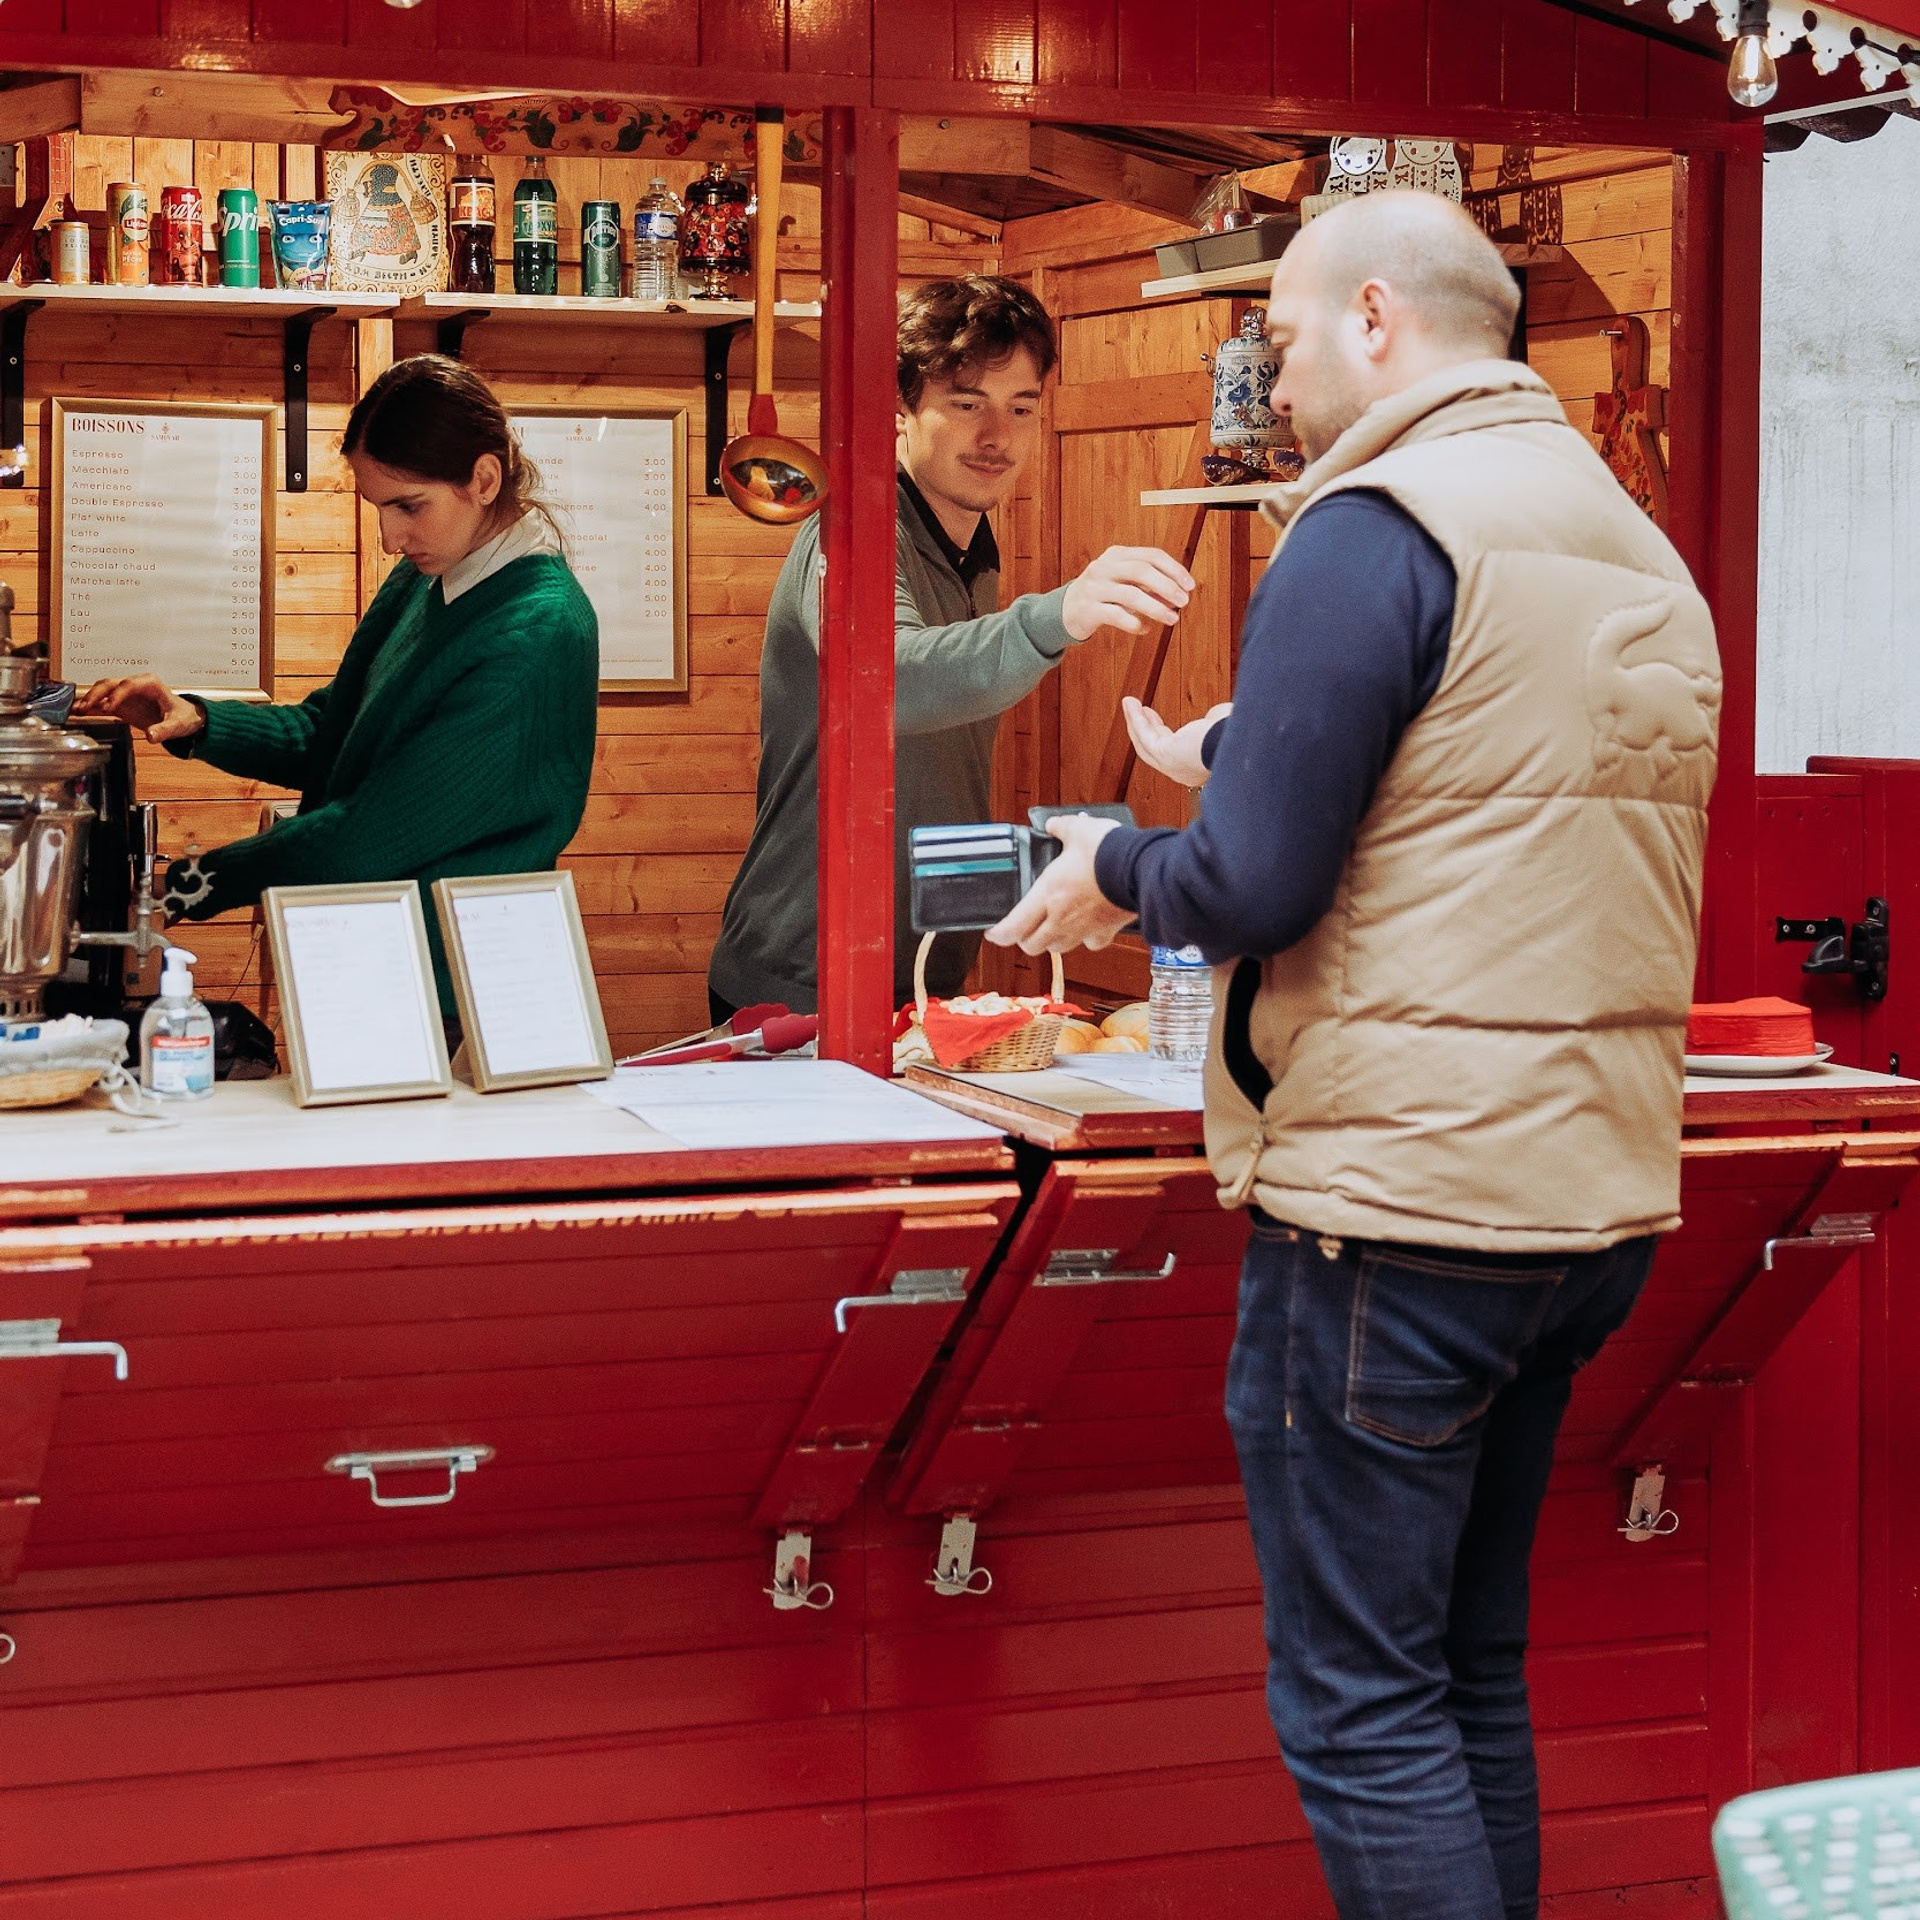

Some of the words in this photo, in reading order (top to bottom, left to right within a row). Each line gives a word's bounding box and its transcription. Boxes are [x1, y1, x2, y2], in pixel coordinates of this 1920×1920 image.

[216, 206, 259, 237] Spri
[279, 213, 324, 227] Capri-Sun
[72, 418, 145, 434] BOISSONS
[72, 449, 124, 459] Espresso
[233, 456, 257, 464] 2.50
[644, 458, 666, 466] 3.00
[71, 465, 129, 475] Macchiato
[233, 471, 257, 480] 3.00
[644, 473, 666, 481] 3.00
[71, 481, 132, 491] Americano
[232, 487, 257, 496] 3.00
[644, 488, 666, 497] 4.00
[71, 497, 108, 506] Double
[112, 499, 164, 509] Espresso
[232, 502, 256, 511] 3.50
[644, 503, 666, 512] 4.00
[71, 513, 91, 521] Flat
[96, 514, 127, 522] white
[233, 518, 256, 527] 4.50
[71, 529, 100, 537] Latte
[644, 533, 667, 542] 4.00
[70, 545, 135, 555] Cappuccino
[232, 549, 256, 558] 5.00
[644, 549, 667, 557] 4.00
[70, 561, 118, 570] Chocolat
[123, 562, 156, 571] chaud
[232, 565, 256, 573] 4.50
[644, 564, 667, 572] 4.00
[70, 577, 111, 586] Matcha
[116, 578, 141, 587] latte
[645, 579, 667, 587] 4.00
[70, 592, 91, 601] Thé
[232, 595, 256, 604] 3.00
[645, 594, 667, 602] 5.00
[70, 608, 90, 617] Eau
[232, 611, 255, 620] 2.50
[645, 609, 667, 618] 2.00
[70, 624, 92, 633] Soft
[231, 627, 255, 635] 3.00
[231, 642, 255, 651] 3.00
[231, 658, 255, 666] 5.00
